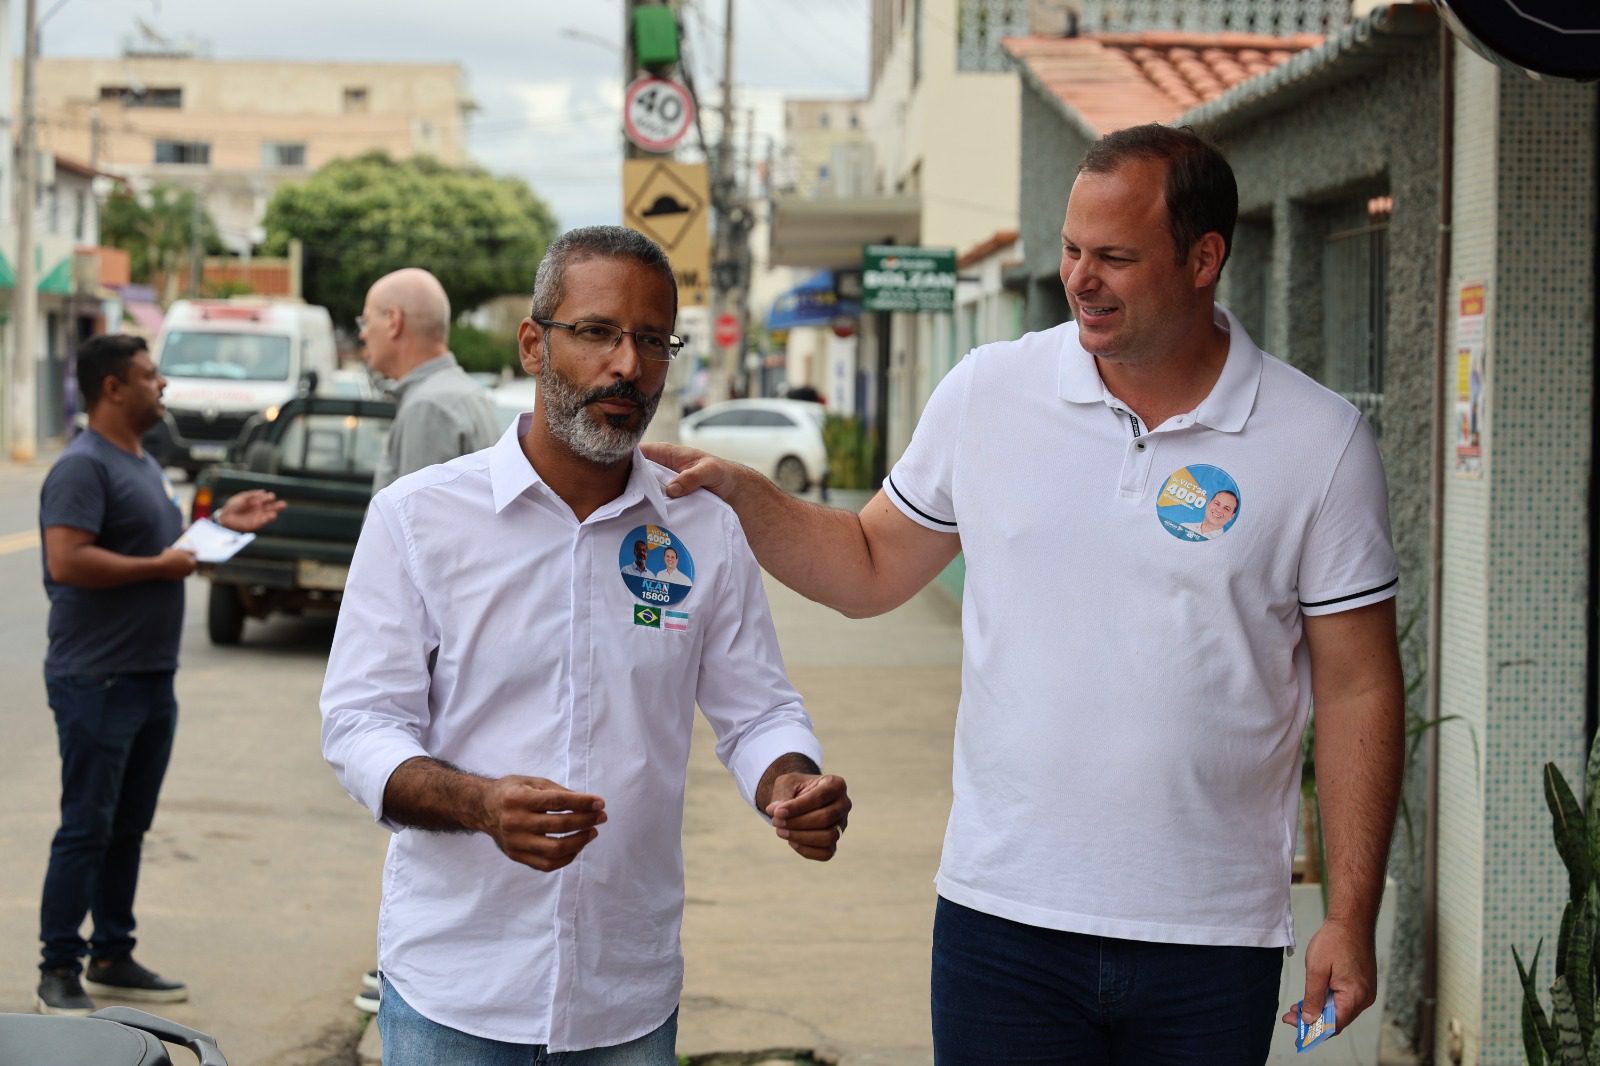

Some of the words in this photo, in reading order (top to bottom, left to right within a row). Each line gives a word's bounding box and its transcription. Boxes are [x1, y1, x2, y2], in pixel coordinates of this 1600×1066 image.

[637, 90, 682, 122] 40
[863, 270, 957, 289] BOLZAN
[1167, 483, 1207, 509] 4000
[646, 533, 672, 546] 4000
[641, 591, 670, 603] 15800
